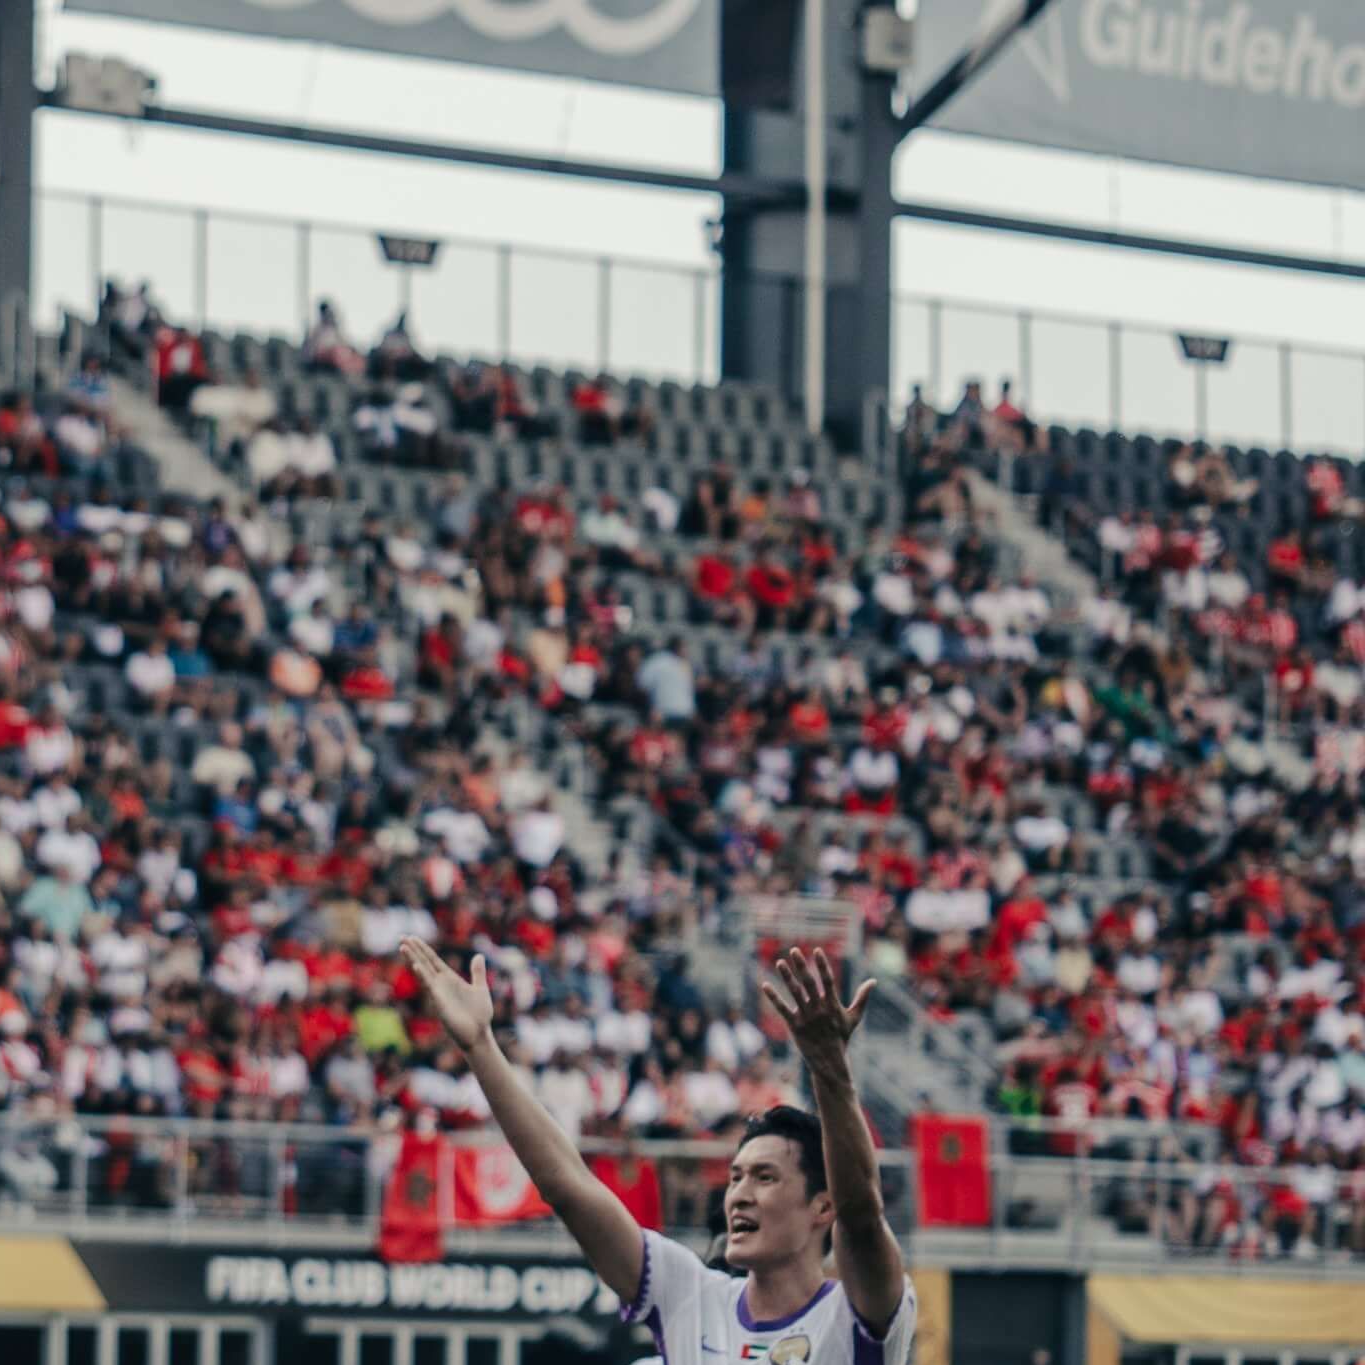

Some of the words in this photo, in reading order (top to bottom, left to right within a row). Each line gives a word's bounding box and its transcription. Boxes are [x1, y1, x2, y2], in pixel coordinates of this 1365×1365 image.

[208, 1256, 289, 1304] FIFA
[292, 1258, 386, 1307] CLUB
[389, 1262, 519, 1311] WORLD
[521, 1266, 597, 1314] CUP
